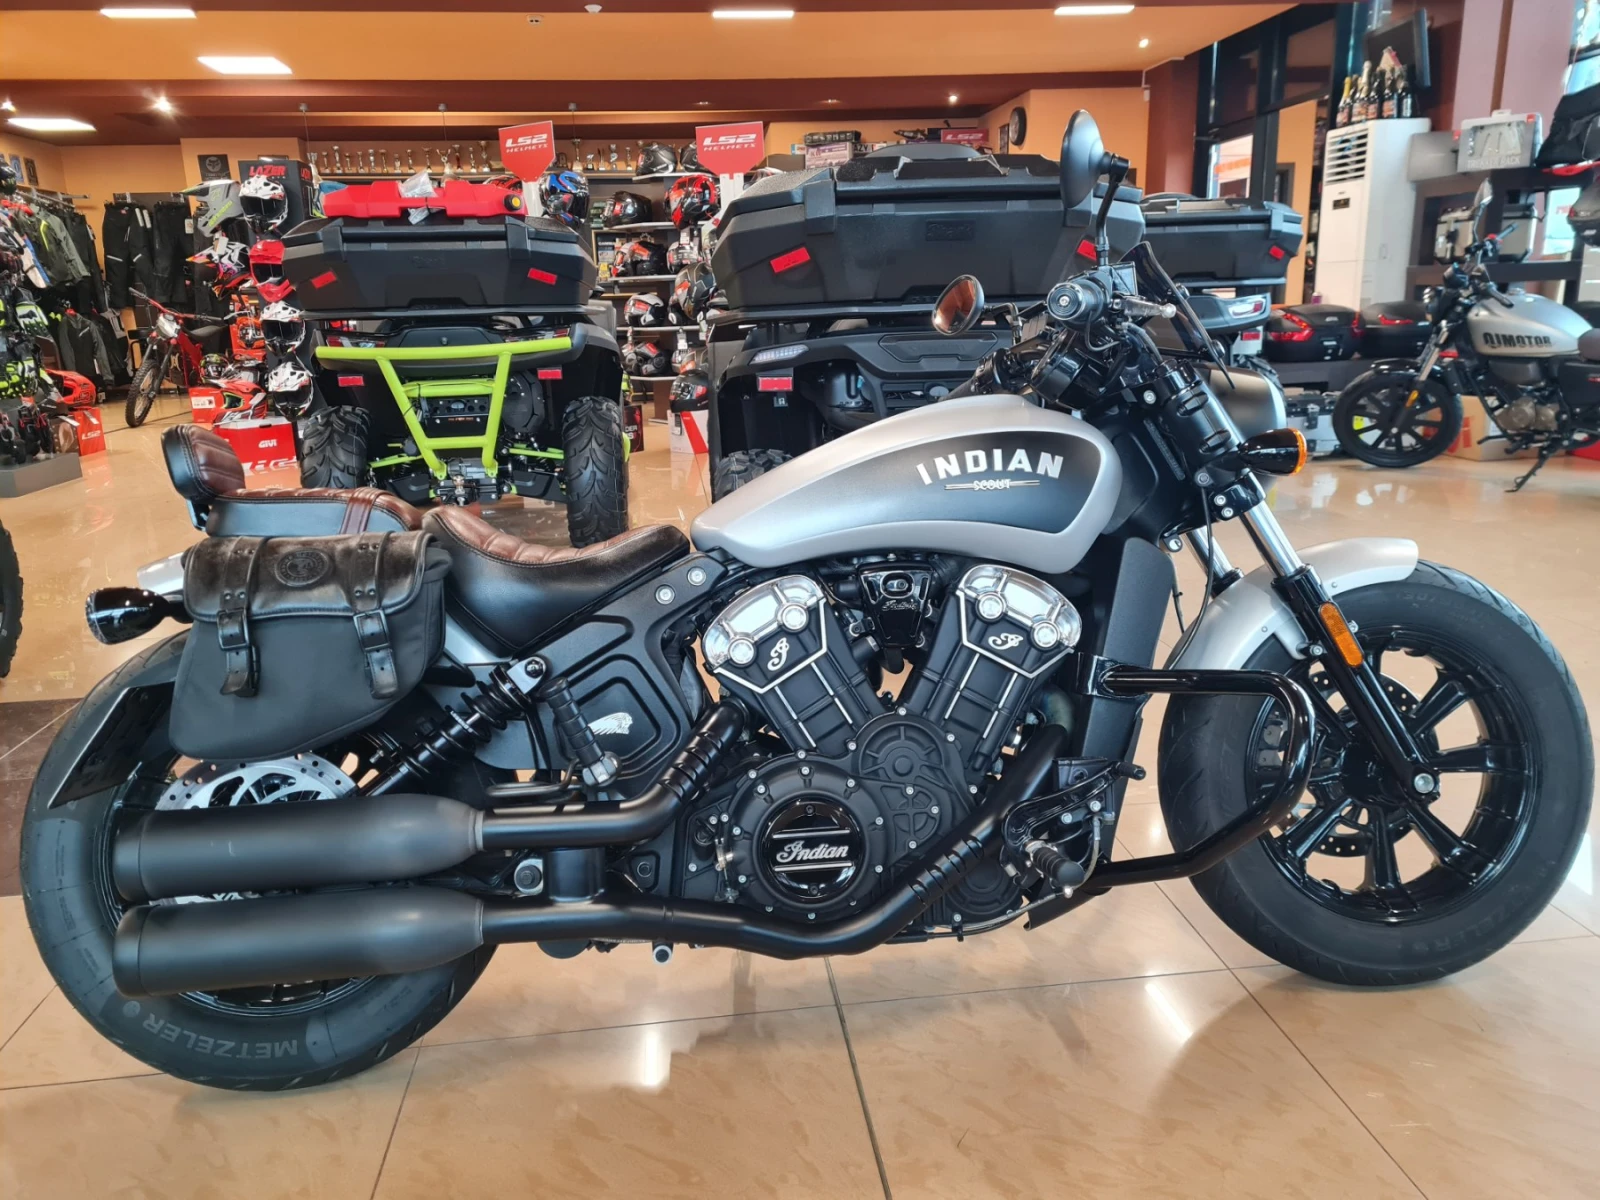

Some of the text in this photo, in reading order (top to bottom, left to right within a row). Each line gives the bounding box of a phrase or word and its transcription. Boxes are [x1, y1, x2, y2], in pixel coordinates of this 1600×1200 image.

[505, 133, 548, 148] LS2
[703, 133, 757, 146] LS2
[506, 143, 549, 153] HELMETS
[703, 143, 756, 152] HELMETS
[249, 164, 287, 177] LAZER
[81, 430, 101, 440] LS2
[258, 439, 278, 449] GIVI
[916, 448, 1064, 486] INDIAN
[973, 478, 1012, 491] SCOUT
[776, 840, 849, 863] Indian
[142, 1012, 298, 1059] METZELER
